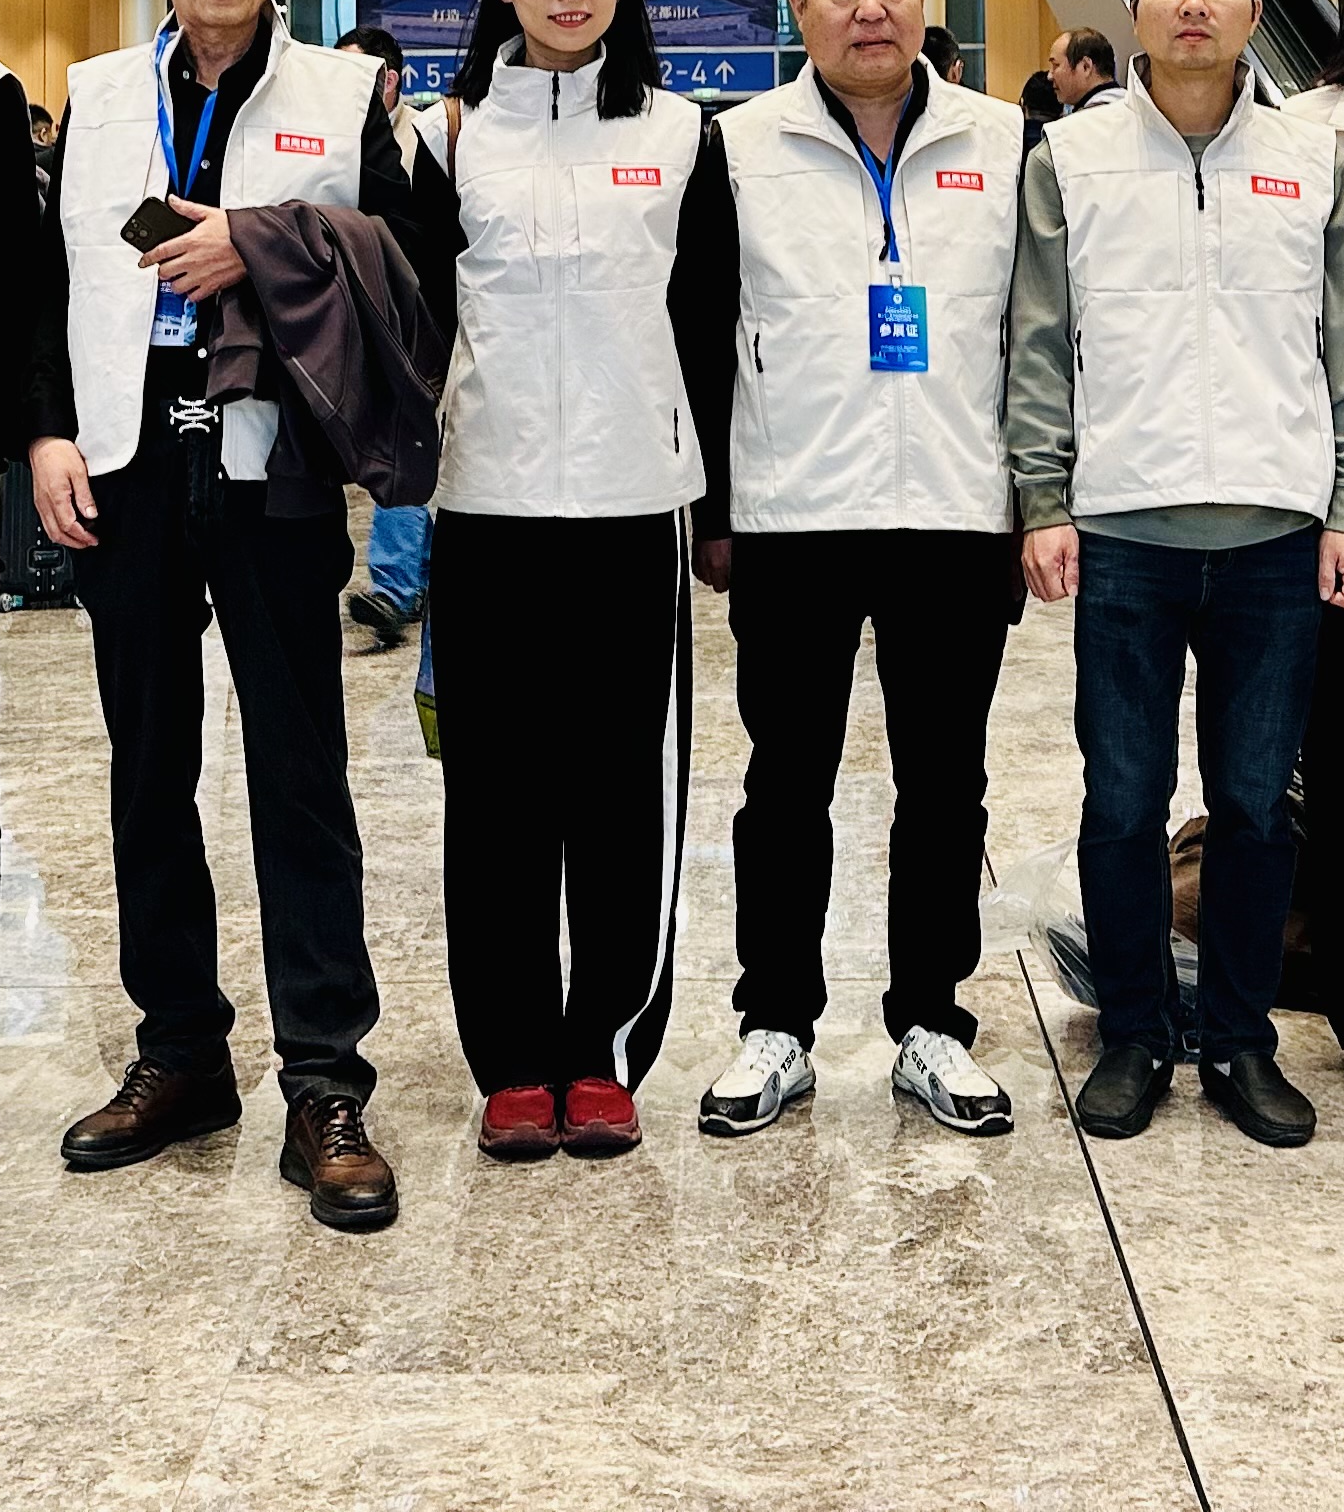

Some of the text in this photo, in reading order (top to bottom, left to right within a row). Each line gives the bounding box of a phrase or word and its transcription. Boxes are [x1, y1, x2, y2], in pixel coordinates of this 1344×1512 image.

[426, 63, 463, 88] 5-
[659, 59, 707, 85] 2-4
[879, 323, 919, 337] 参展证
[912, 1051, 928, 1074] GET
